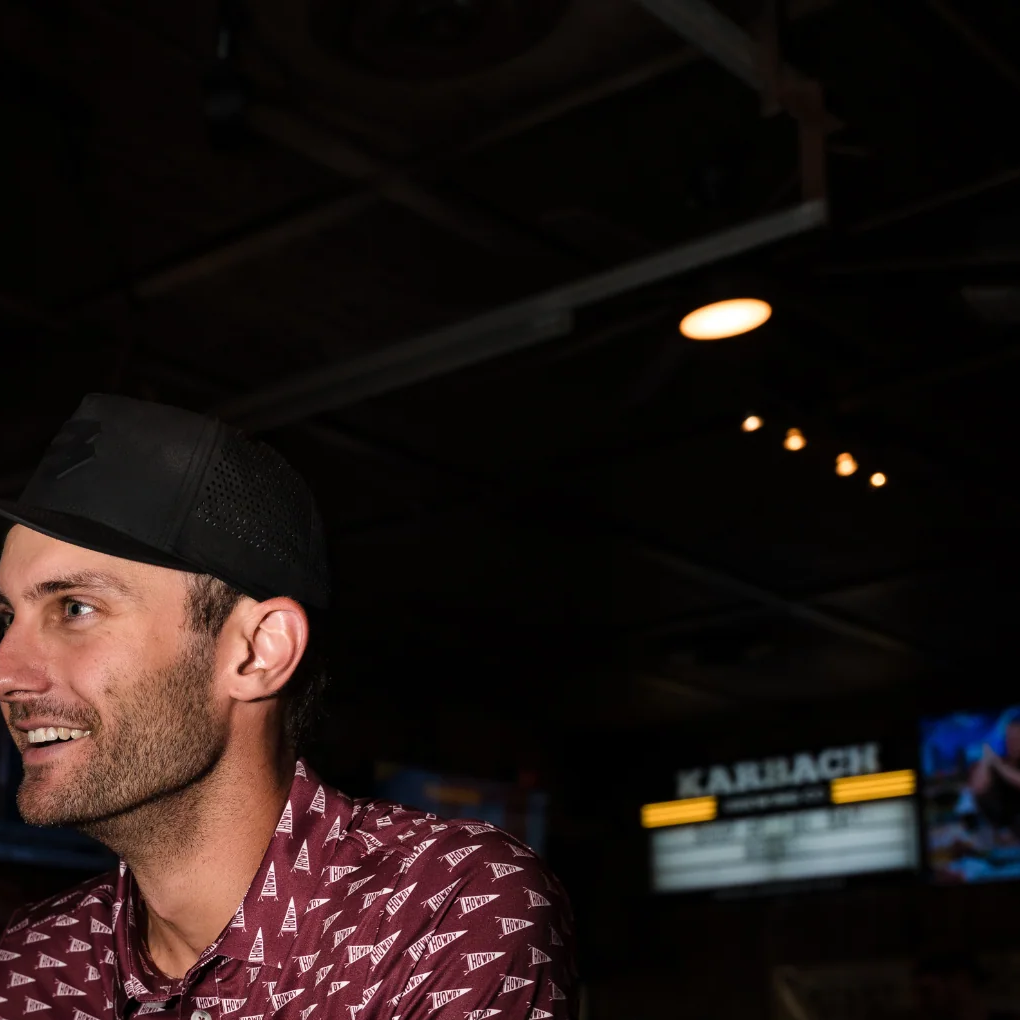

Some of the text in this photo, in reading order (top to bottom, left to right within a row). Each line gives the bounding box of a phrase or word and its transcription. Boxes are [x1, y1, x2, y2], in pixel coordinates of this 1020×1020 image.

[673, 740, 883, 798] KARBACH
[311, 789, 324, 810] HOWDY
[278, 808, 292, 830] HOWDY
[295, 848, 308, 868] HOWDY
[448, 847, 474, 864] HOWDY
[494, 863, 517, 876] HOWDY
[262, 871, 275, 893] HOWDY
[387, 889, 410, 912] HOWDY
[430, 885, 453, 908] HOWDY
[464, 896, 490, 912] HOWDY
[282, 907, 296, 928] HOWDY
[504, 919, 526, 933] HOWDY
[250, 937, 262, 958] HOWDY
[373, 937, 394, 957] HOWDY
[432, 932, 457, 953] HOWDY
[471, 953, 495, 968] HOWDY
[506, 976, 525, 991] HOWDY
[276, 990, 297, 1010] HOWDY
[436, 990, 460, 1006] HOWDY
